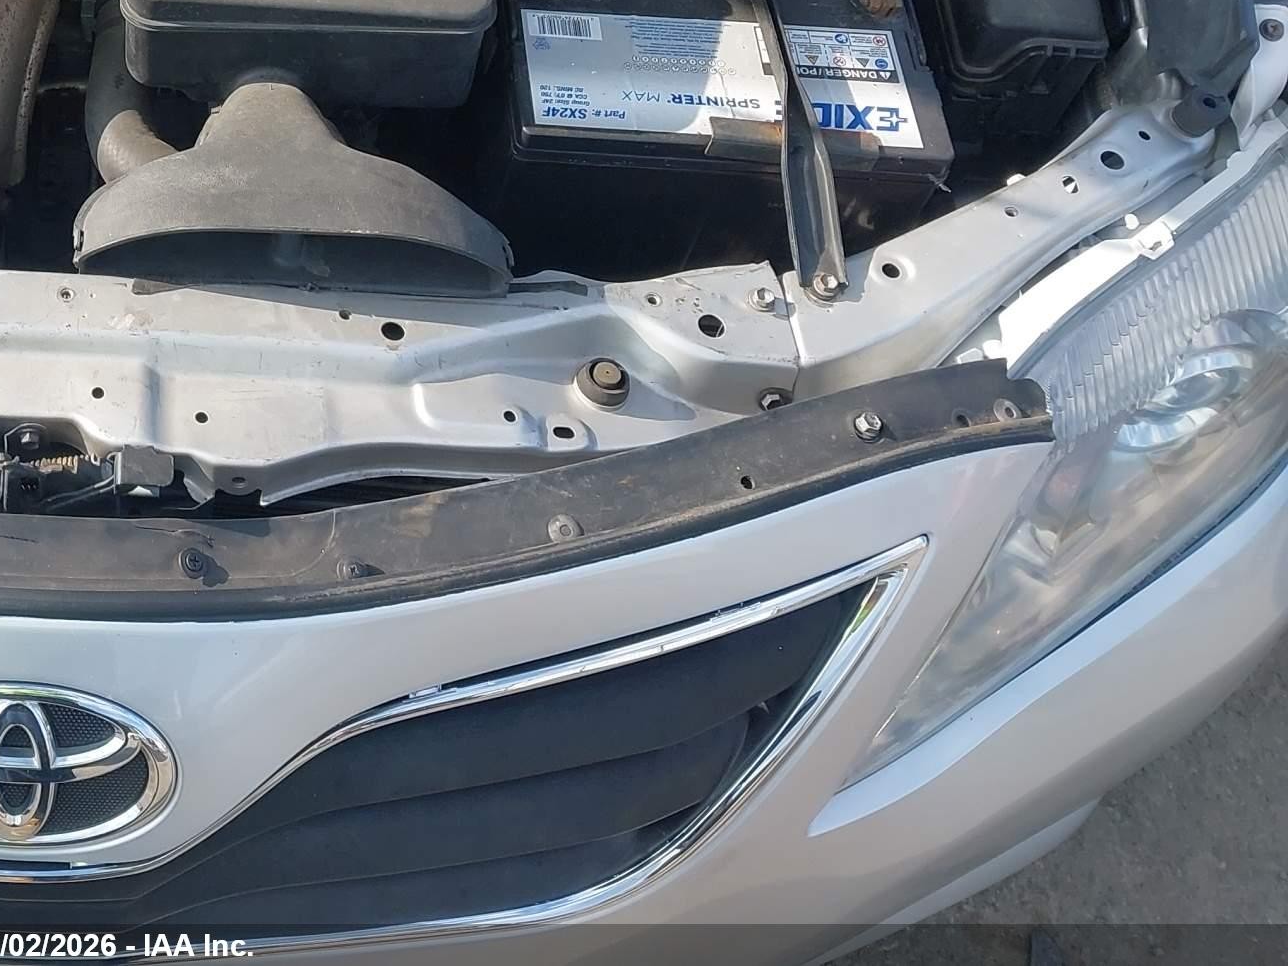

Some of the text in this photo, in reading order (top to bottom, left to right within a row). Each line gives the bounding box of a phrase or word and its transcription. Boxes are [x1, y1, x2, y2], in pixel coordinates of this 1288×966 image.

[621, 91, 661, 103] MAX
[542, 107, 588, 120] SX24F
[605, 110, 626, 120] Part
[774, 101, 908, 132] EXID
